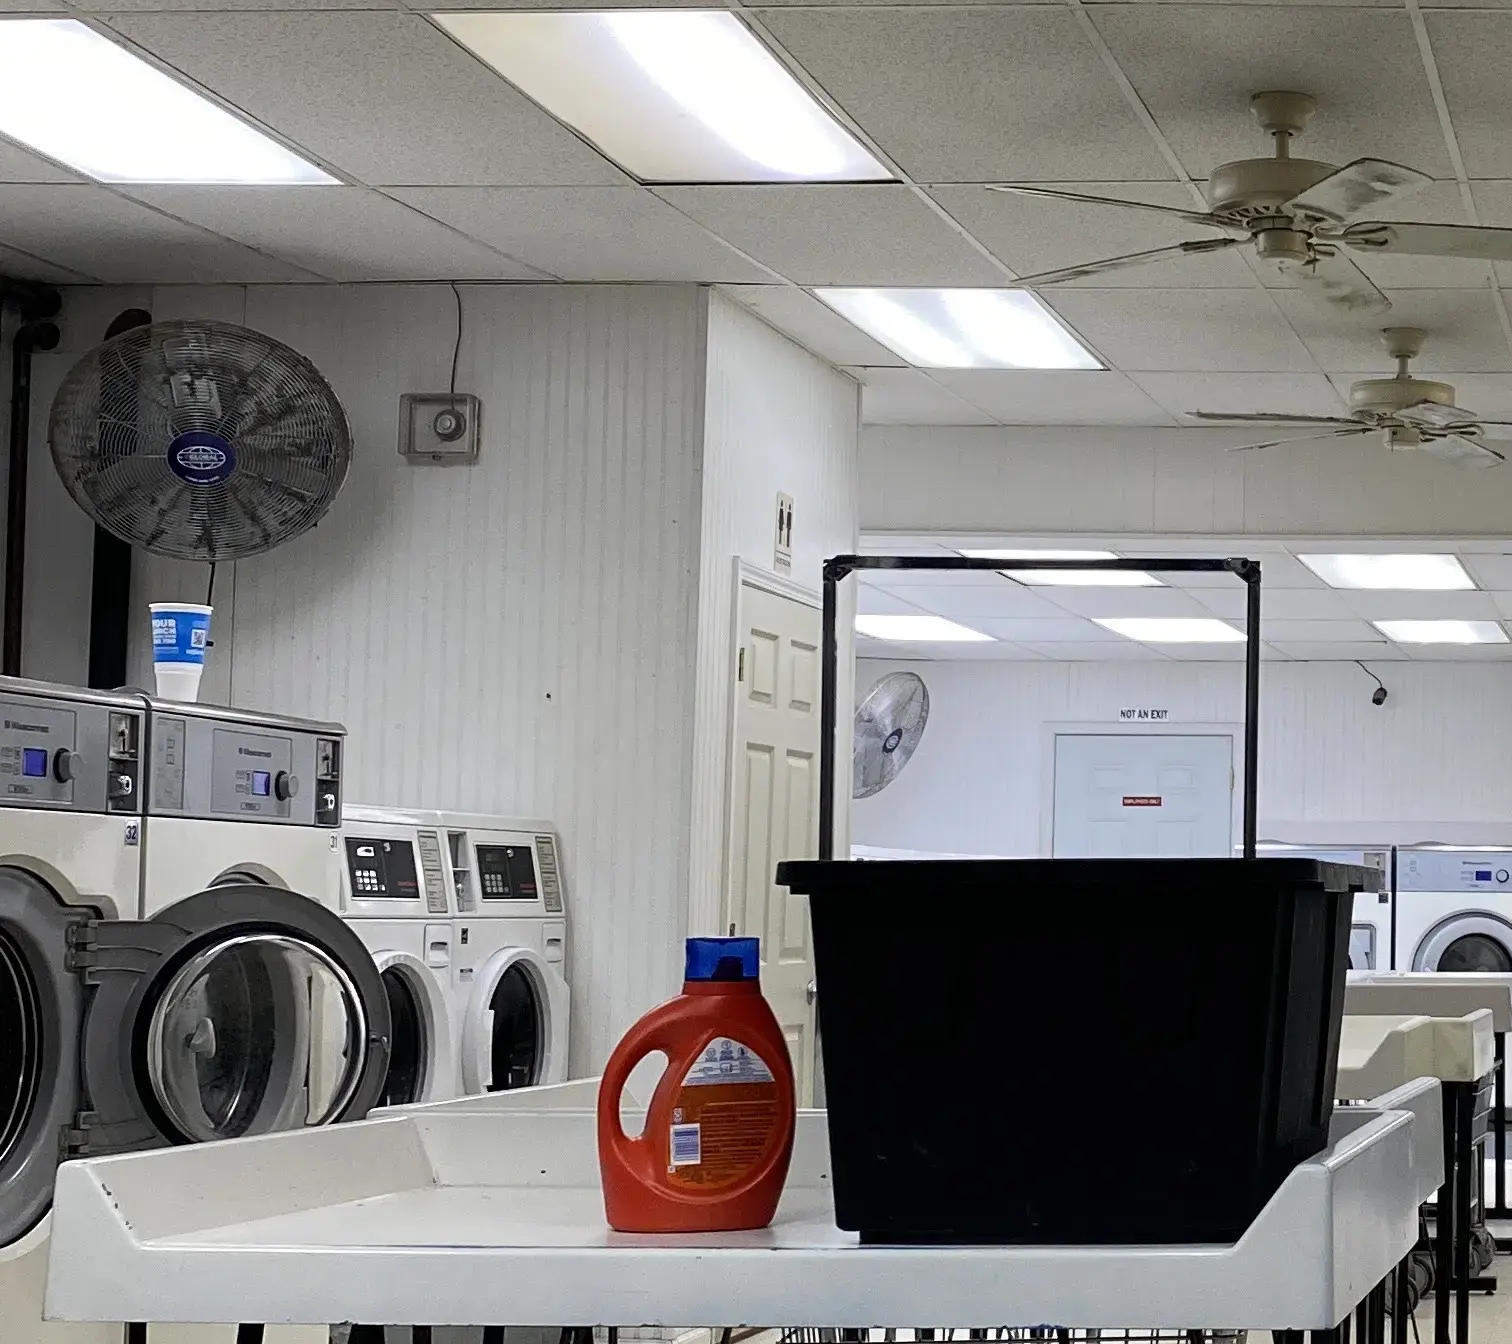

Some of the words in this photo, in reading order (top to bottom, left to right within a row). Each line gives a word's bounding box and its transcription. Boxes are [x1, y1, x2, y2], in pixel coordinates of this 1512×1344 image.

[1120, 709, 1136, 719] NOT
[1137, 709, 1149, 719] AN
[1150, 709, 1168, 719] EXIT
[126, 825, 137, 840] 32
[330, 835, 338, 849] 31
